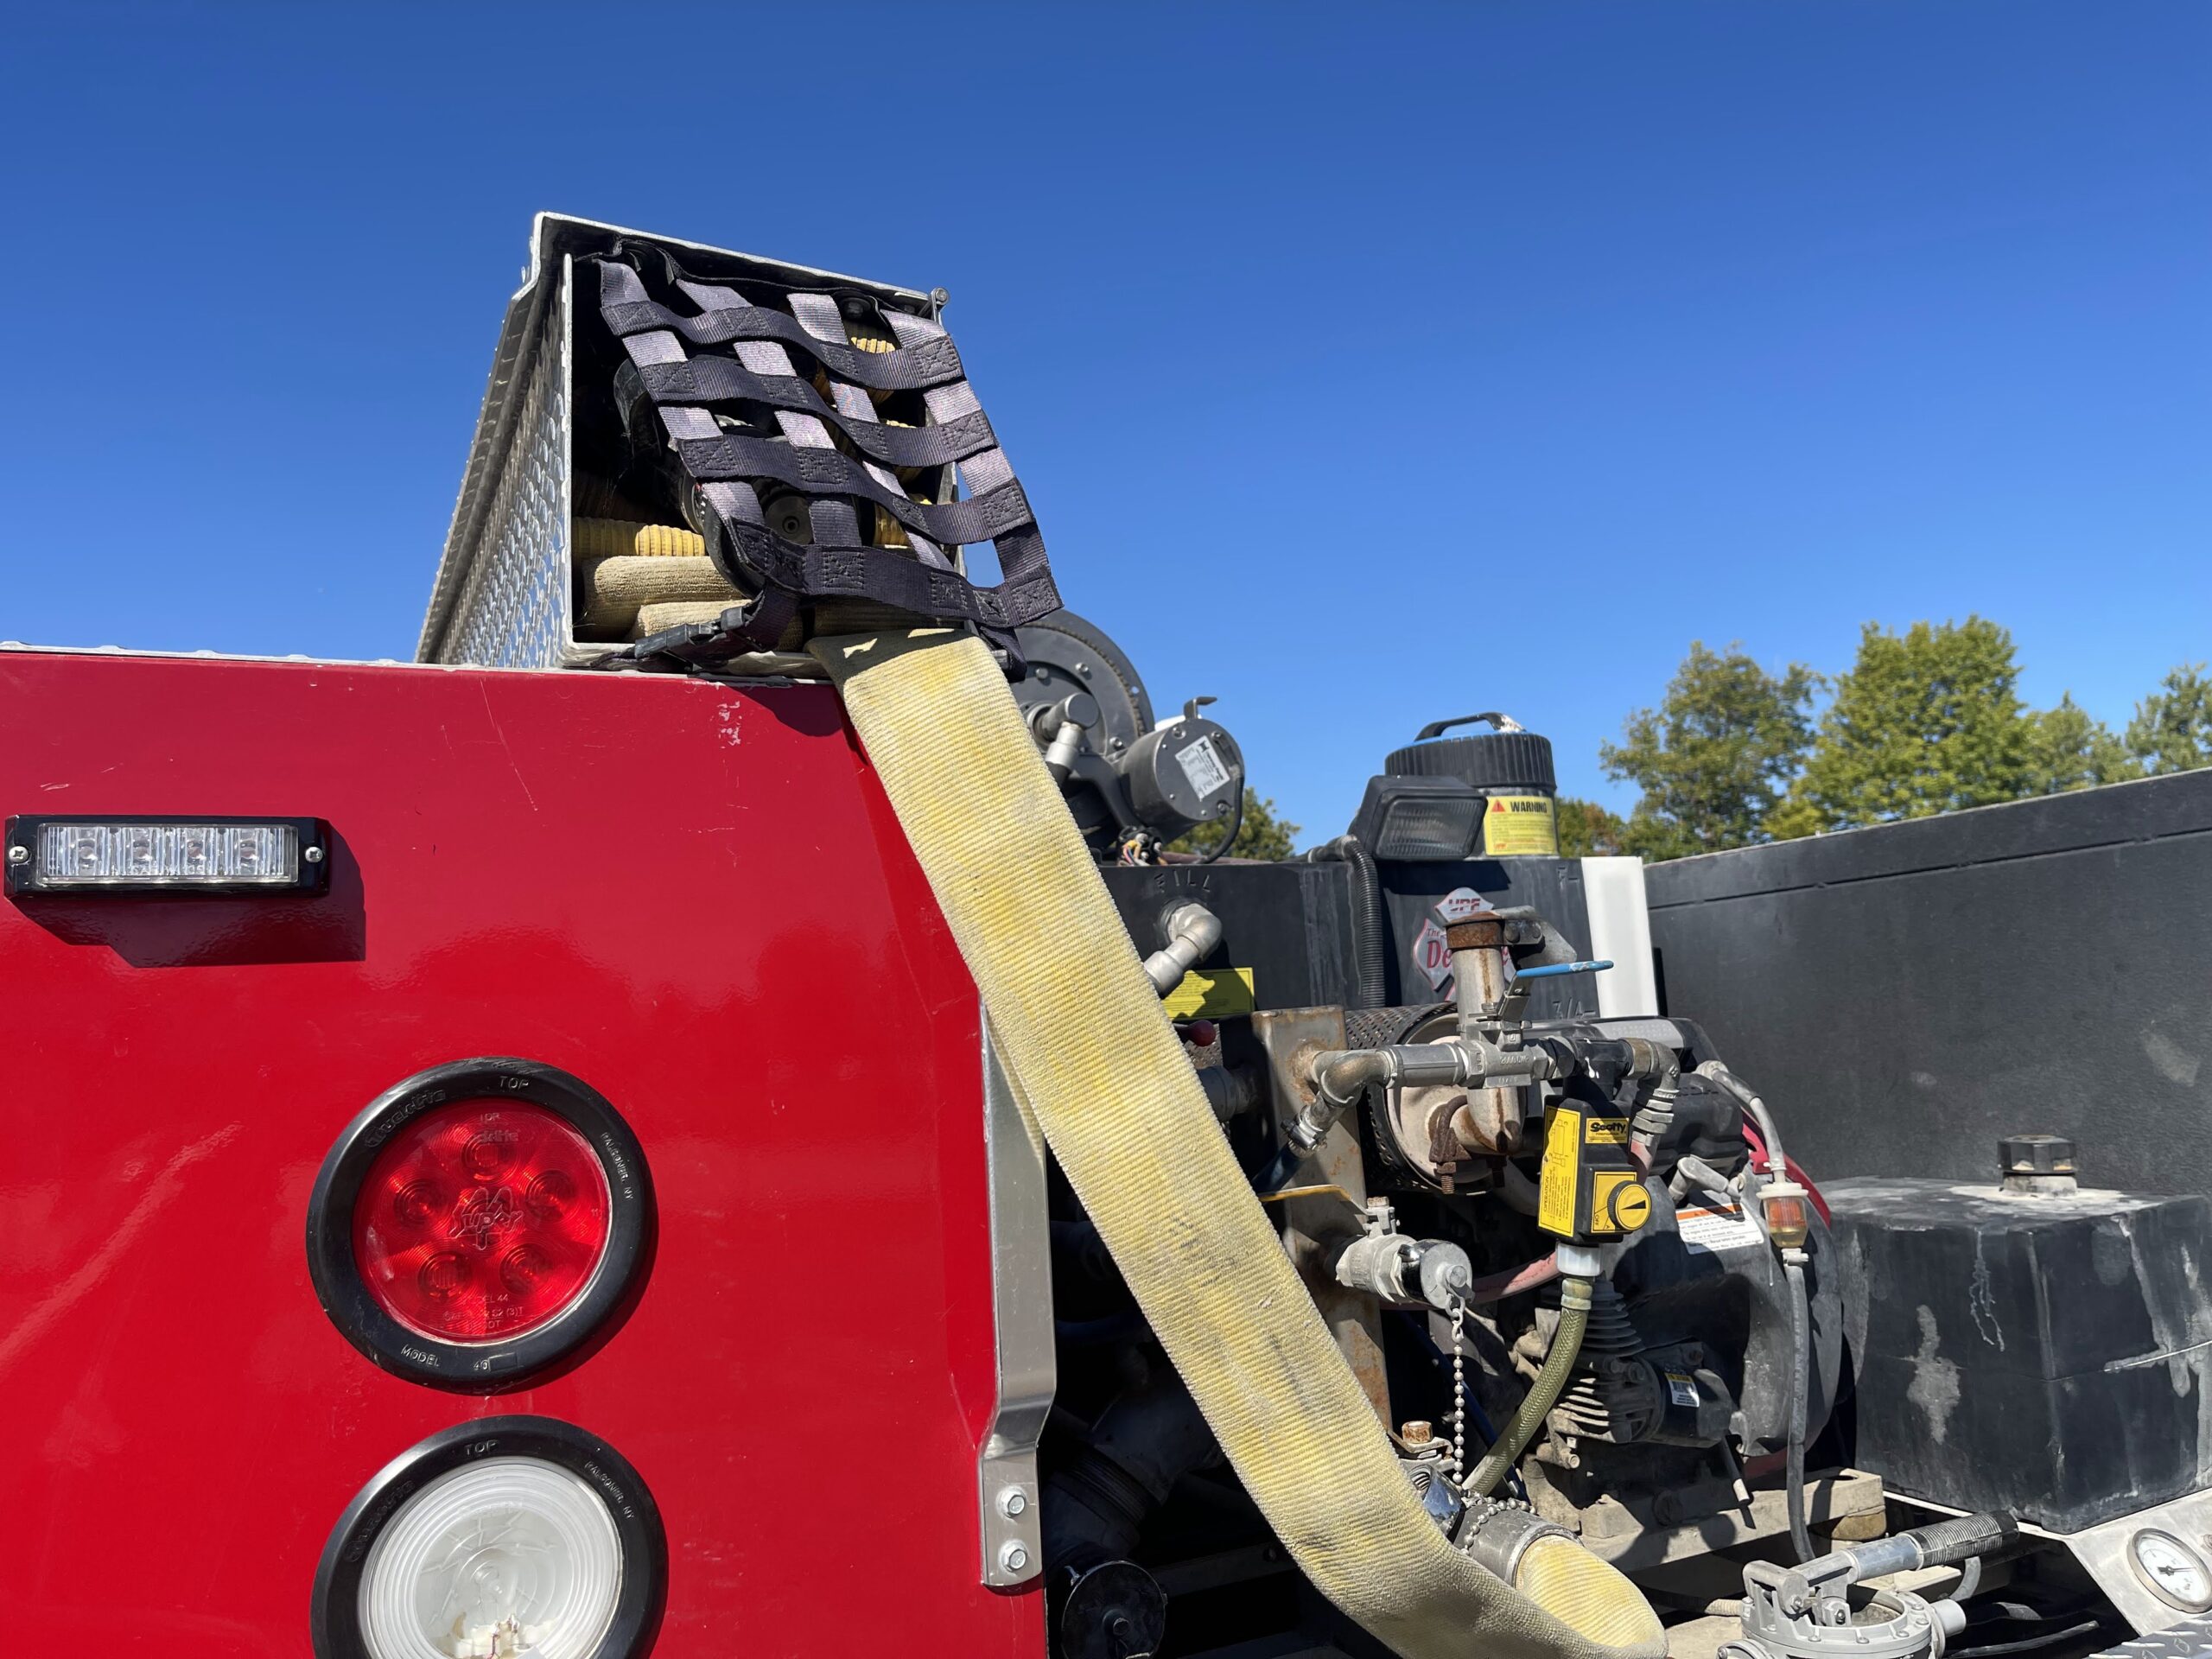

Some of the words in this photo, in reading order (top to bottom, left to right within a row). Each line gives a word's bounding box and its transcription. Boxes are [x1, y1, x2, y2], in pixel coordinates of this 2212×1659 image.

[1510, 801, 1548, 813] WARNING
[1154, 869, 1211, 893] FILL
[499, 1076, 529, 1090] TOP
[1590, 1122, 1625, 1134] Scotty
[401, 1344, 440, 1368] MODEL
[463, 1440, 499, 1458] TOP
